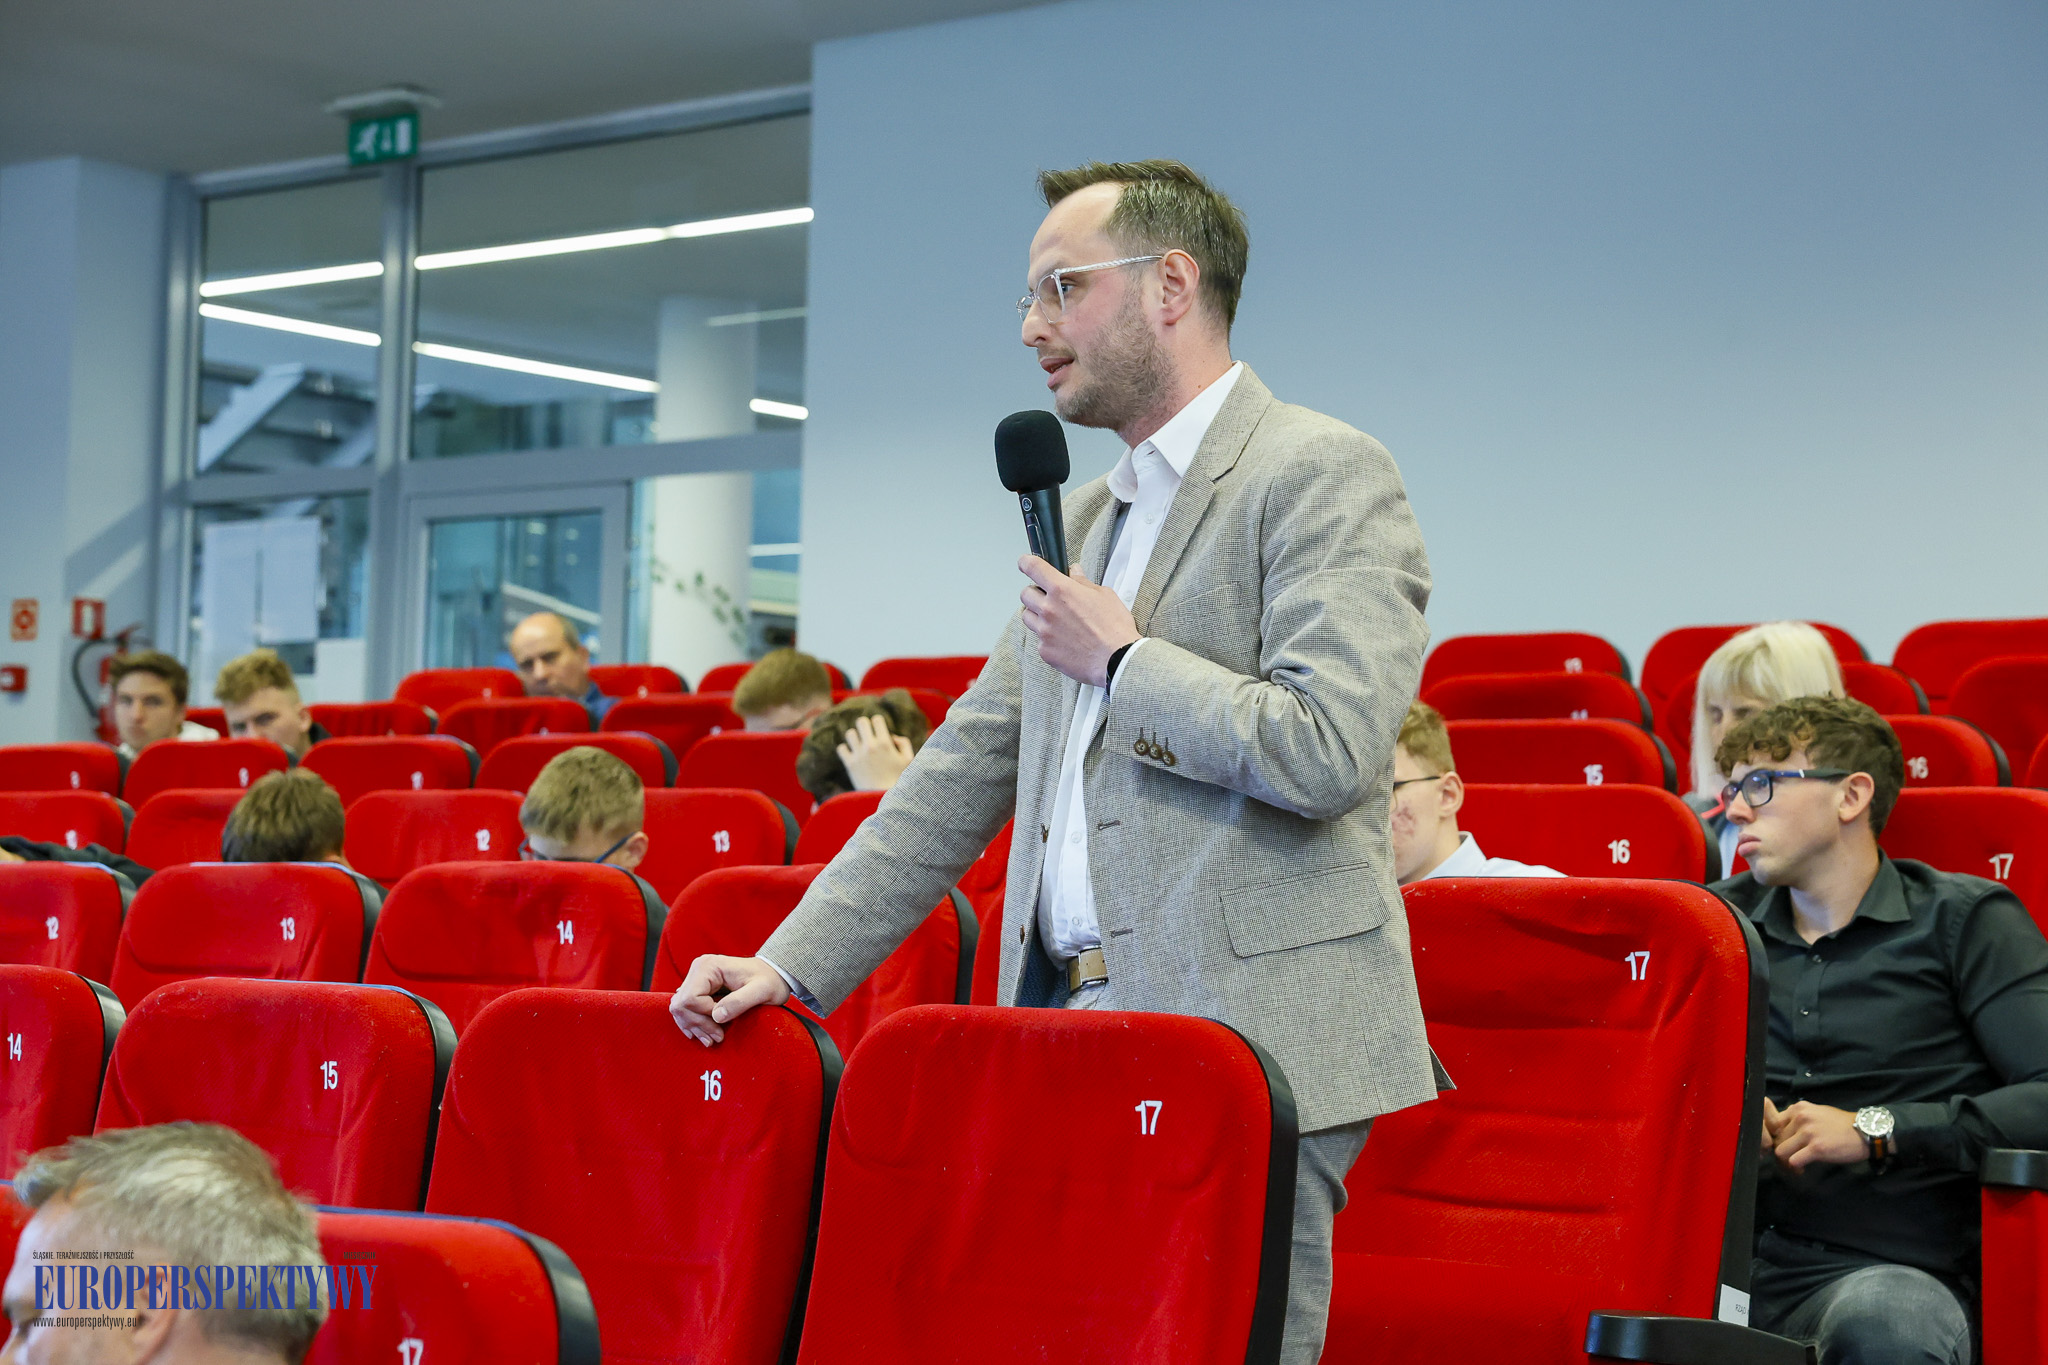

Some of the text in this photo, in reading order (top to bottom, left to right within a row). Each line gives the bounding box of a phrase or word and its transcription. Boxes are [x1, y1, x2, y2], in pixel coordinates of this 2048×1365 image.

[1607, 839, 1631, 864] 16
[1988, 853, 2014, 880] 17
[45, 916, 59, 940] 12
[280, 916, 296, 941] 13
[556, 920, 574, 945] 14
[1624, 950, 1651, 981] 17
[7, 1032, 22, 1062] 14
[319, 1060, 338, 1090] 15
[699, 1069, 722, 1102] 16
[1134, 1100, 1163, 1136] 17
[396, 1338, 424, 1365] 17
